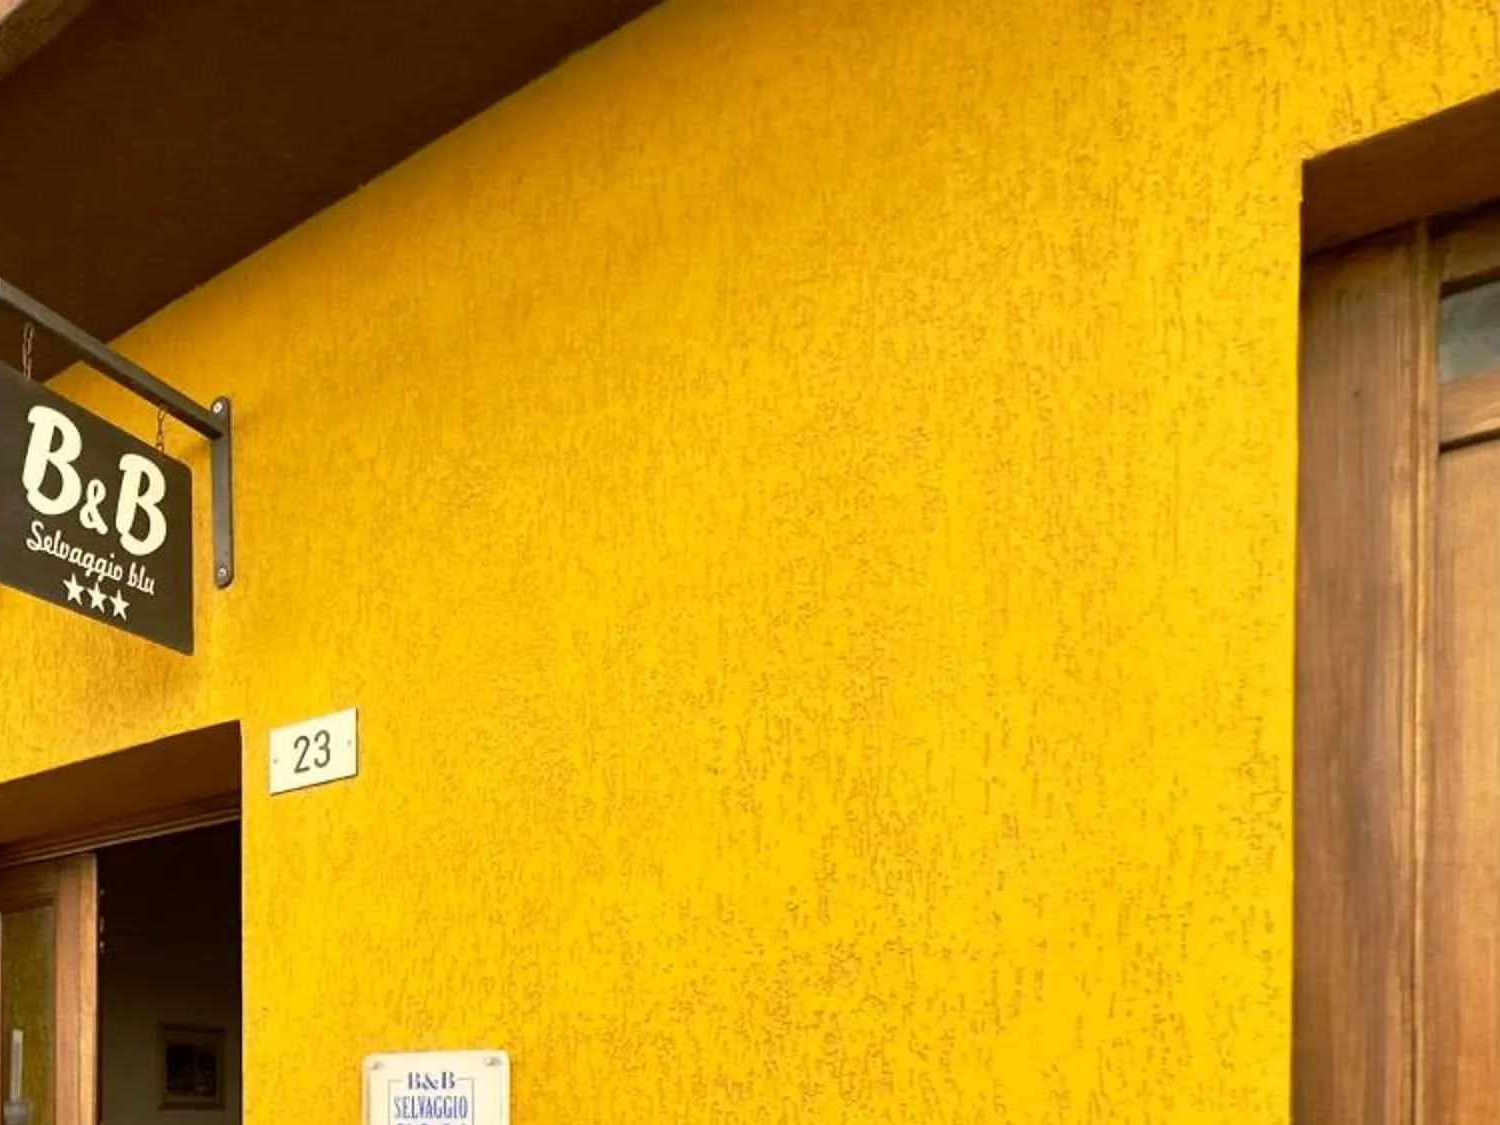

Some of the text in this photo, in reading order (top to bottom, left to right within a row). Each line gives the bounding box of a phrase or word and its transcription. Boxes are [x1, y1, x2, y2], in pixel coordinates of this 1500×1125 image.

[22, 405, 168, 556] B&B
[25, 519, 155, 596] Selvaggio blu
[293, 729, 331, 774] 23
[407, 1071, 456, 1091] B&B
[393, 1095, 468, 1120] SELVAGGIO
